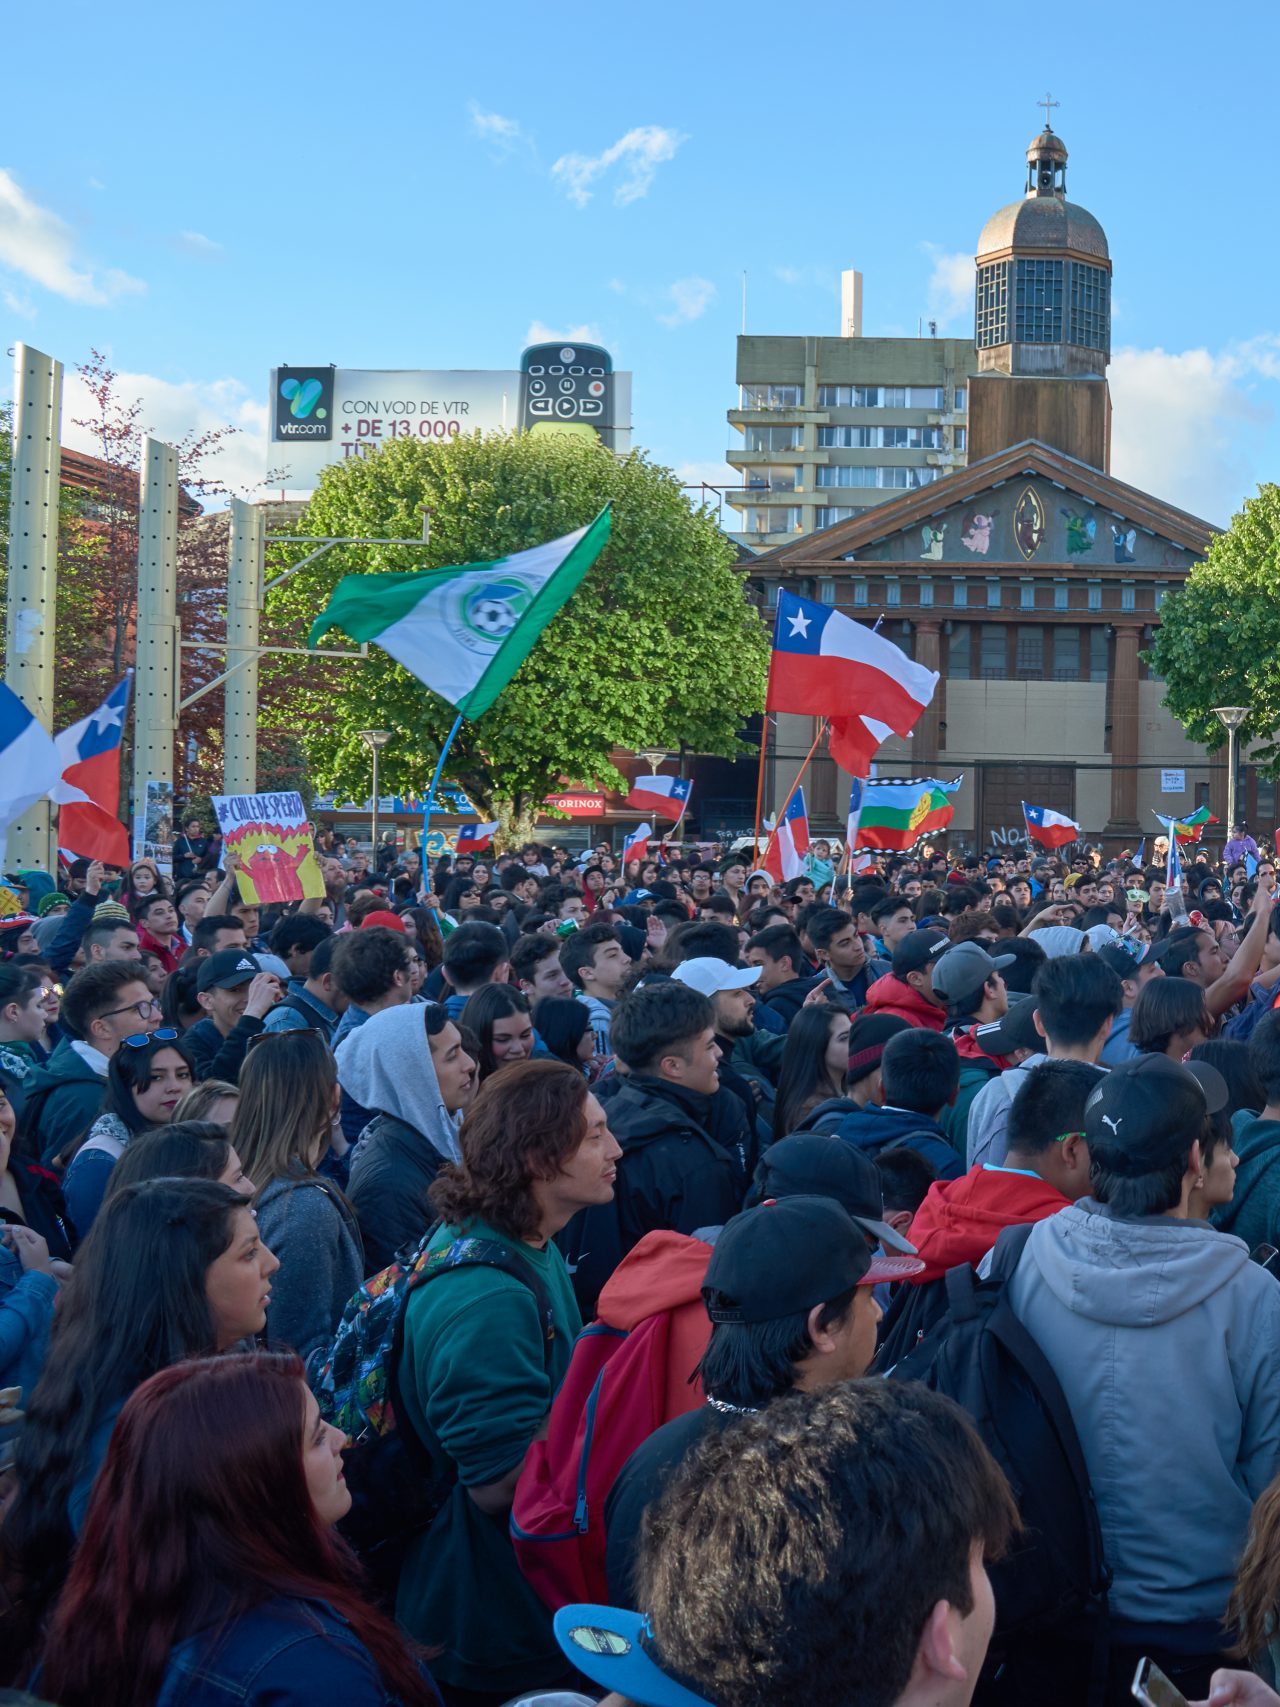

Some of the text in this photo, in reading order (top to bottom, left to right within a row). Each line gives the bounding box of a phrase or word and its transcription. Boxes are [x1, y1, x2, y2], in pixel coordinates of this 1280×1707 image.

[342, 401, 469, 415] CON VOD DE VTR
[280, 423, 326, 434] vtr.com
[341, 420, 460, 437] + DE 13.000
